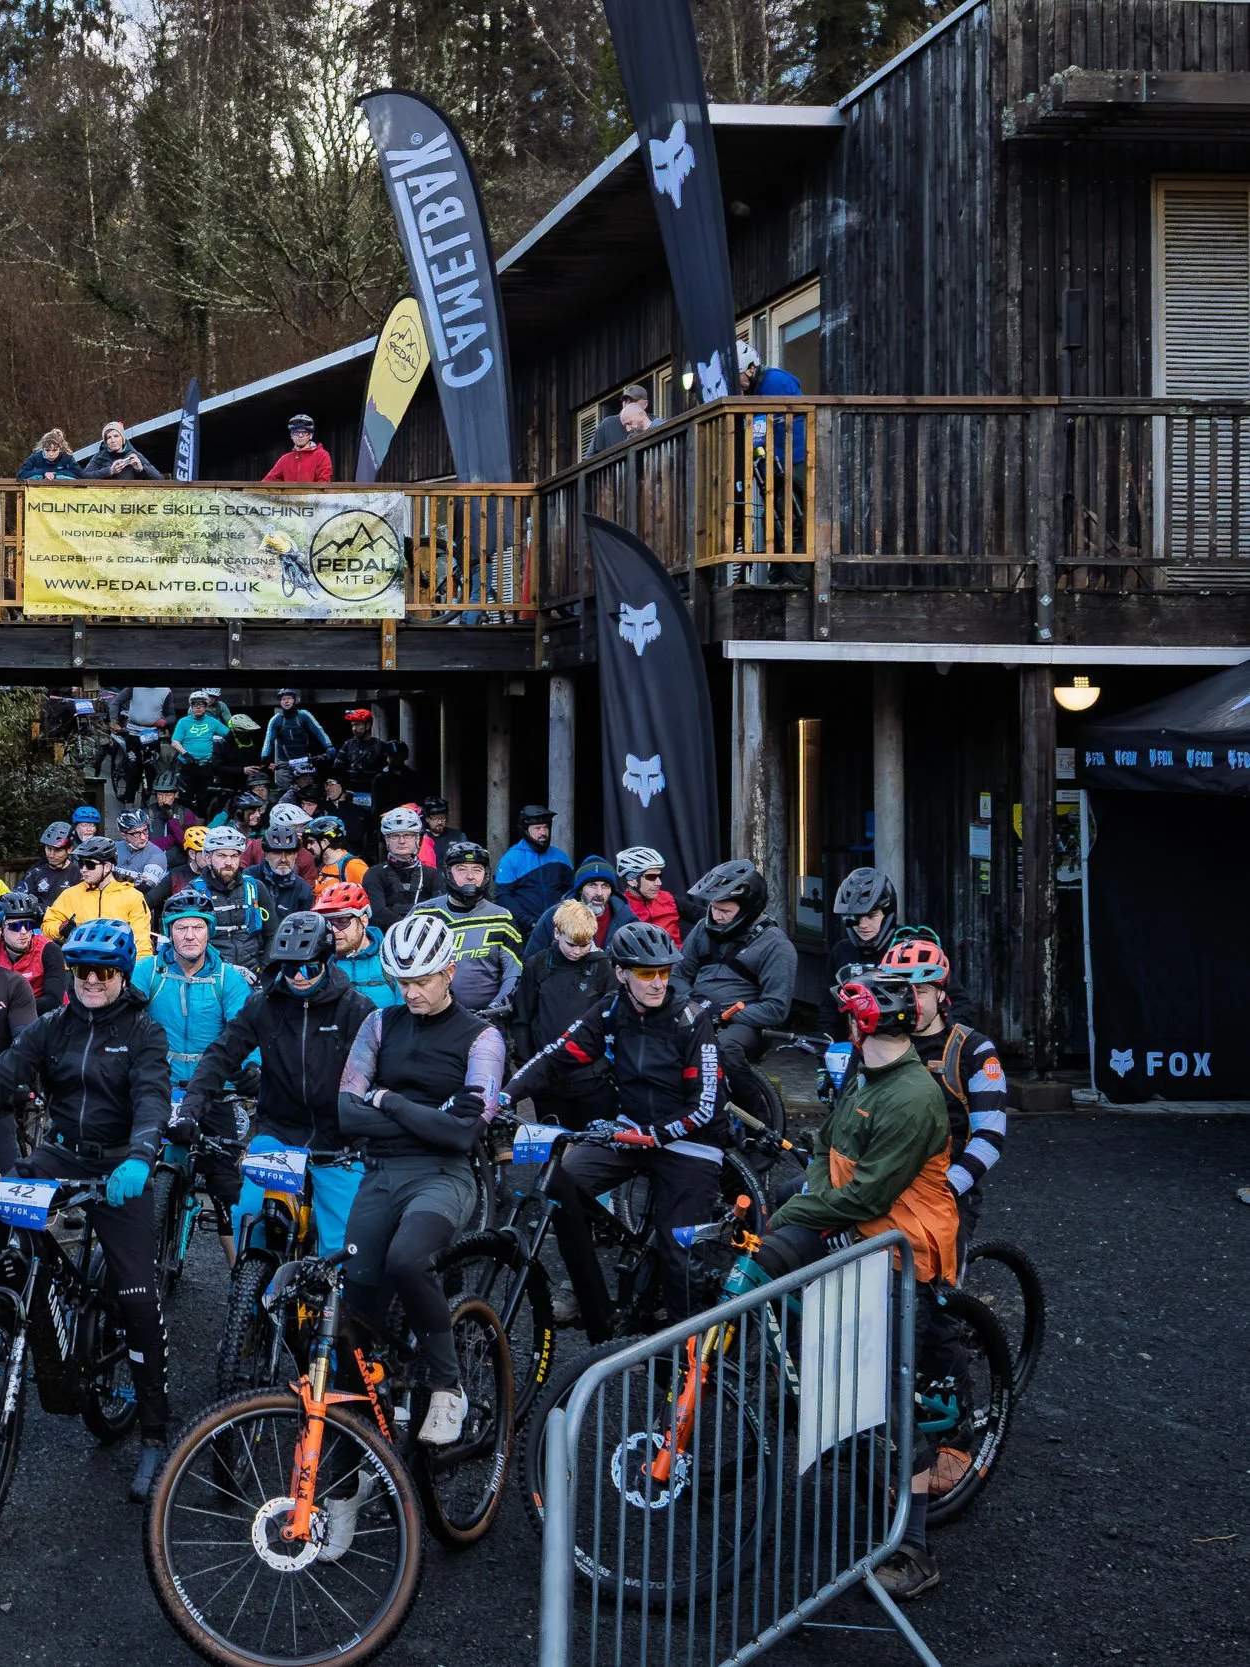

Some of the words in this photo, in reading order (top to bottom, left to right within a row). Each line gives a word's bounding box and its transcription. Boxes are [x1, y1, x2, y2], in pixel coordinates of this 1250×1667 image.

[177, 409, 195, 482] ELBAK
[27, 502, 116, 514] MOUNTAIN
[120, 503, 159, 515] BIKE
[162, 503, 220, 515] SKILLS
[224, 505, 314, 517] COACHING
[61, 530, 125, 538] INDIVIDUAL
[135, 530, 184, 538] GROUPS
[194, 531, 245, 539] FAMILIES
[29, 554, 103, 563] LEADERSHIP
[106, 555, 114, 563] &
[117, 556, 178, 564] COACHING
[182, 557, 276, 565] QUALIFICATIONS
[317, 557, 393, 573] PEDAL
[44, 578, 262, 592] WWW.PEDALMTB.CO.UK
[335, 574, 374, 585] MTB
[1195, 751, 1213, 767] FOX
[1147, 1052, 1211, 1076] FOX
[267, 1172, 284, 1181] FOX
[7, 1184, 36, 1199] 42
[12, 1207, 28, 1216] FOX
[536, 1328, 551, 1383] MAXXIS
[365, 1449, 398, 1496] proven
[172, 1575, 204, 1623] proven
